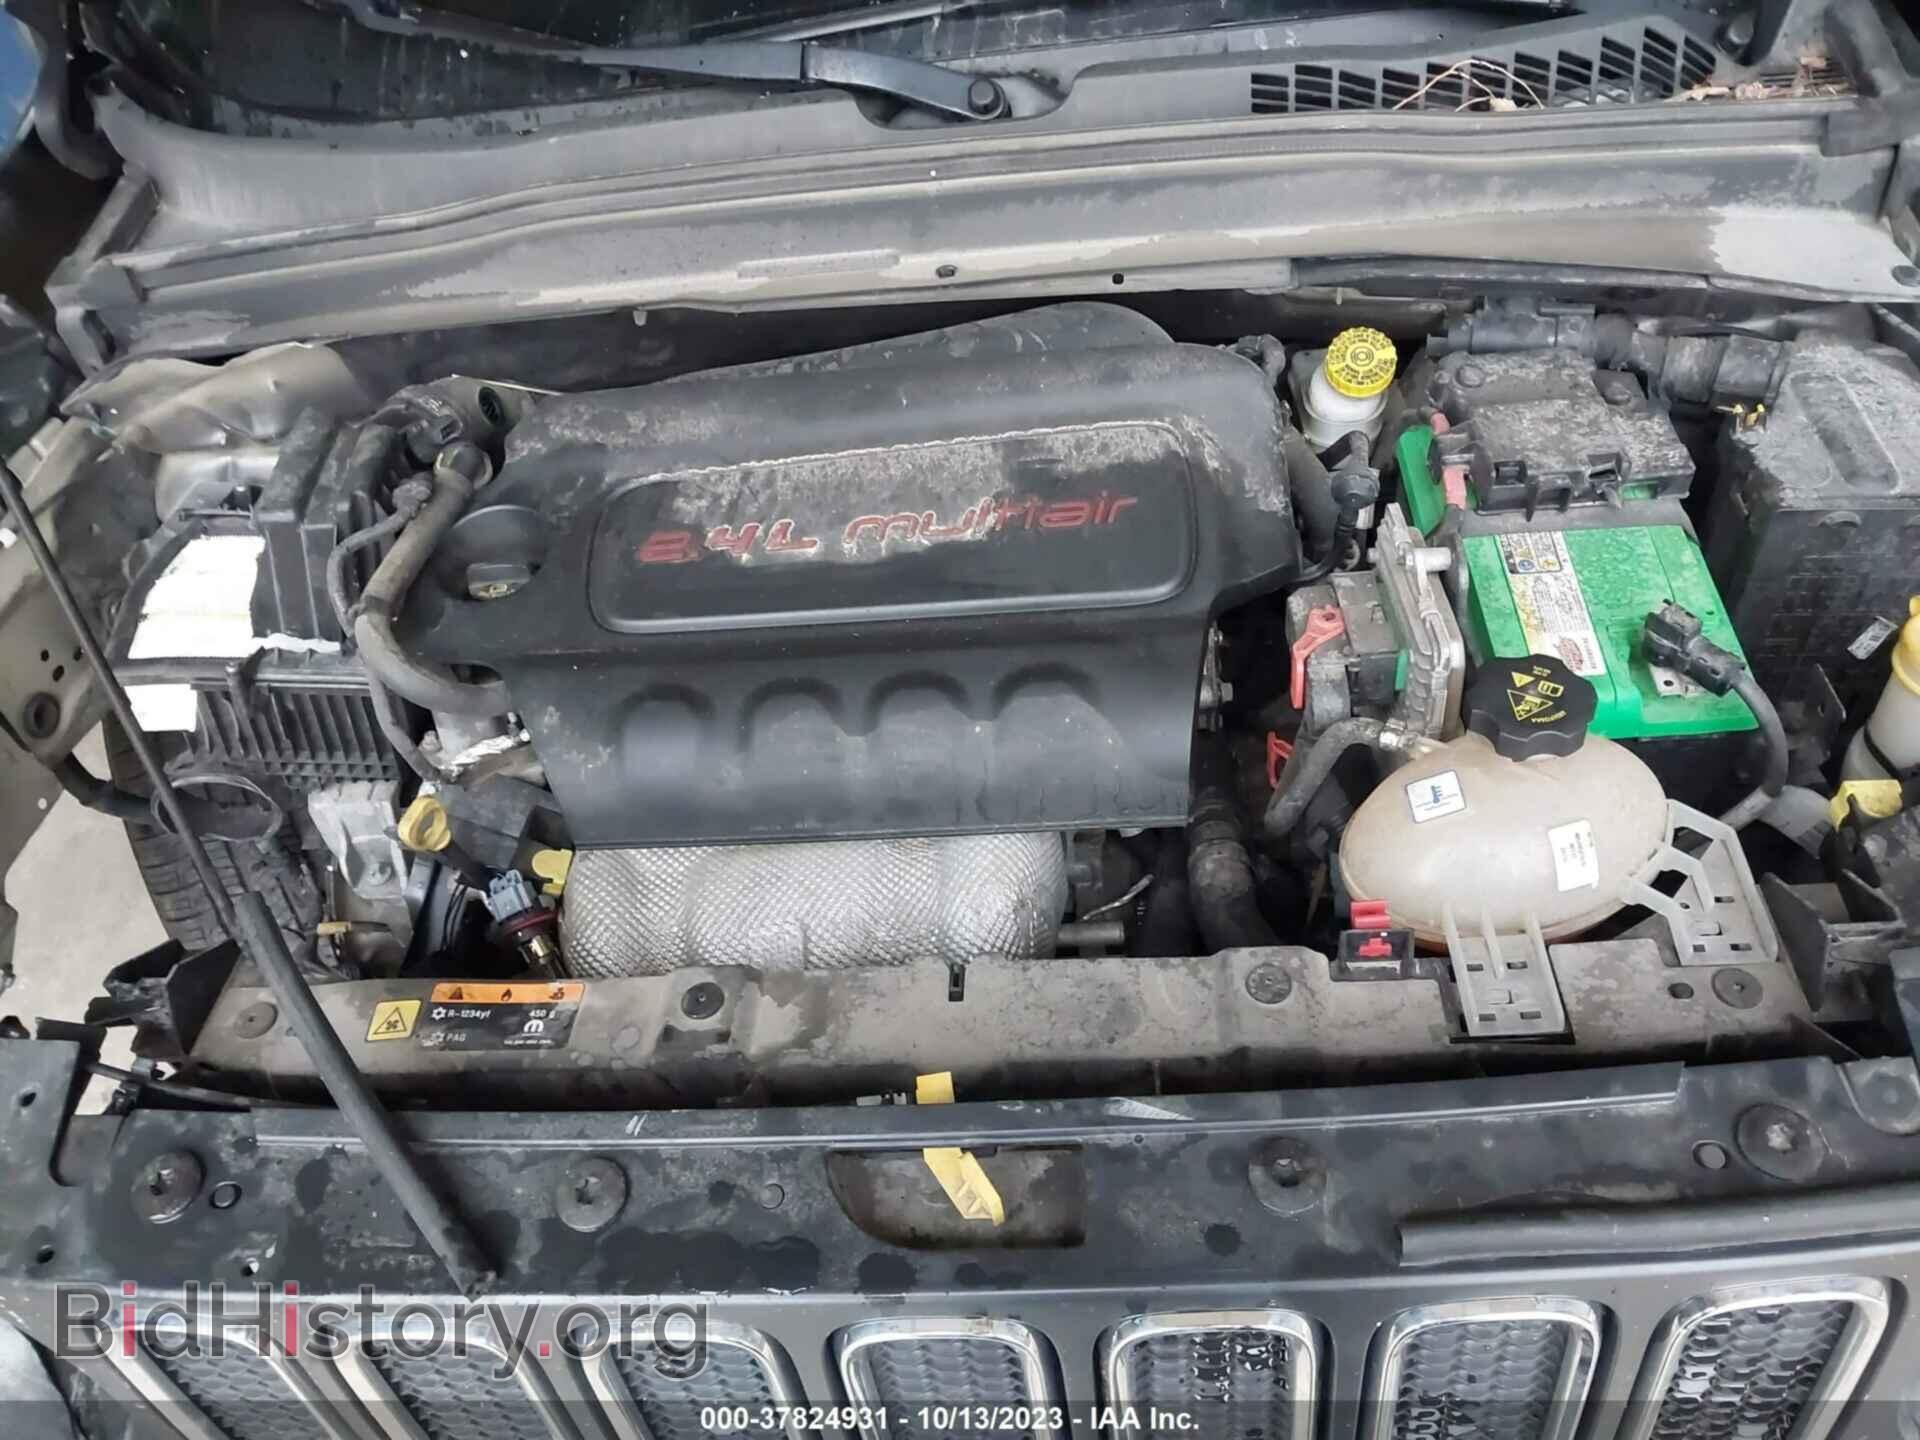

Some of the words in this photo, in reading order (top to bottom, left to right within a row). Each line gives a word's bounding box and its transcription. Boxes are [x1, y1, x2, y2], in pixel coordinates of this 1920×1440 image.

[637, 519, 820, 564] 2.4L
[447, 1008, 491, 1020] R-1234yf
[528, 1008, 547, 1018] 450
